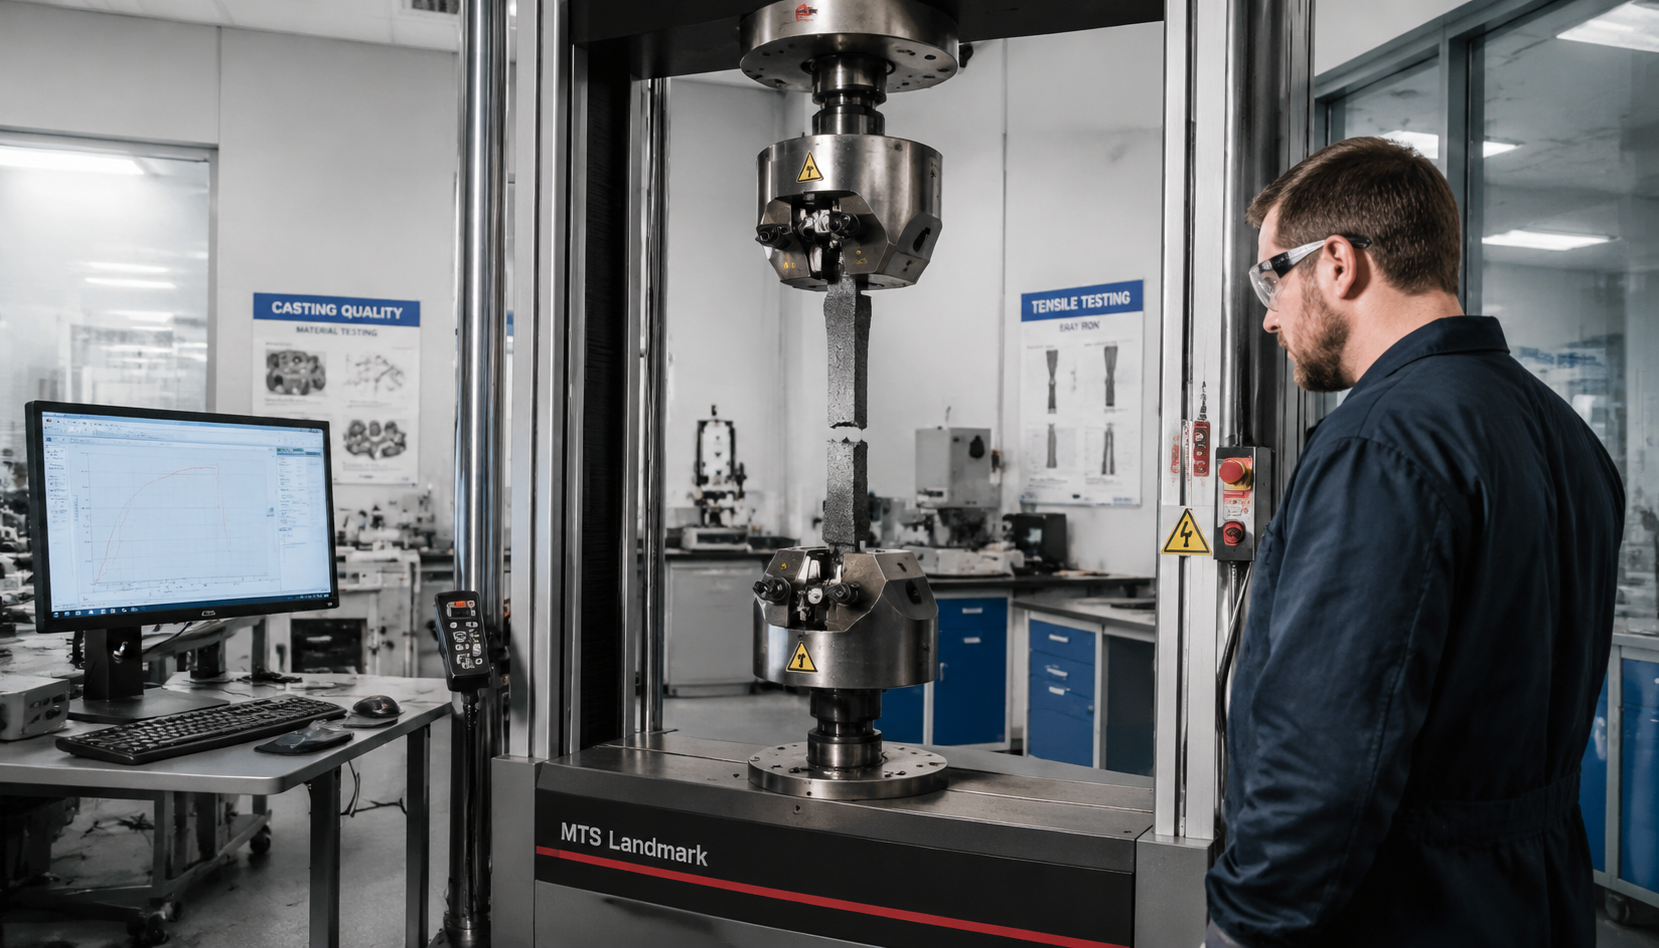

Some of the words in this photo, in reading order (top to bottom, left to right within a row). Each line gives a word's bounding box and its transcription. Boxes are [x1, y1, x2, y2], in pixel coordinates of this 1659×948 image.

[271, 301, 337, 316] CASTING
[341, 304, 403, 320] QUALITY
[1032, 296, 1078, 314] TENSILE
[1081, 290, 1131, 309] TESTING
[296, 326, 339, 335] MATERIAL
[341, 327, 378, 337] TESTING
[561, 822, 601, 847] MTS
[609, 830, 708, 867] Landmark
